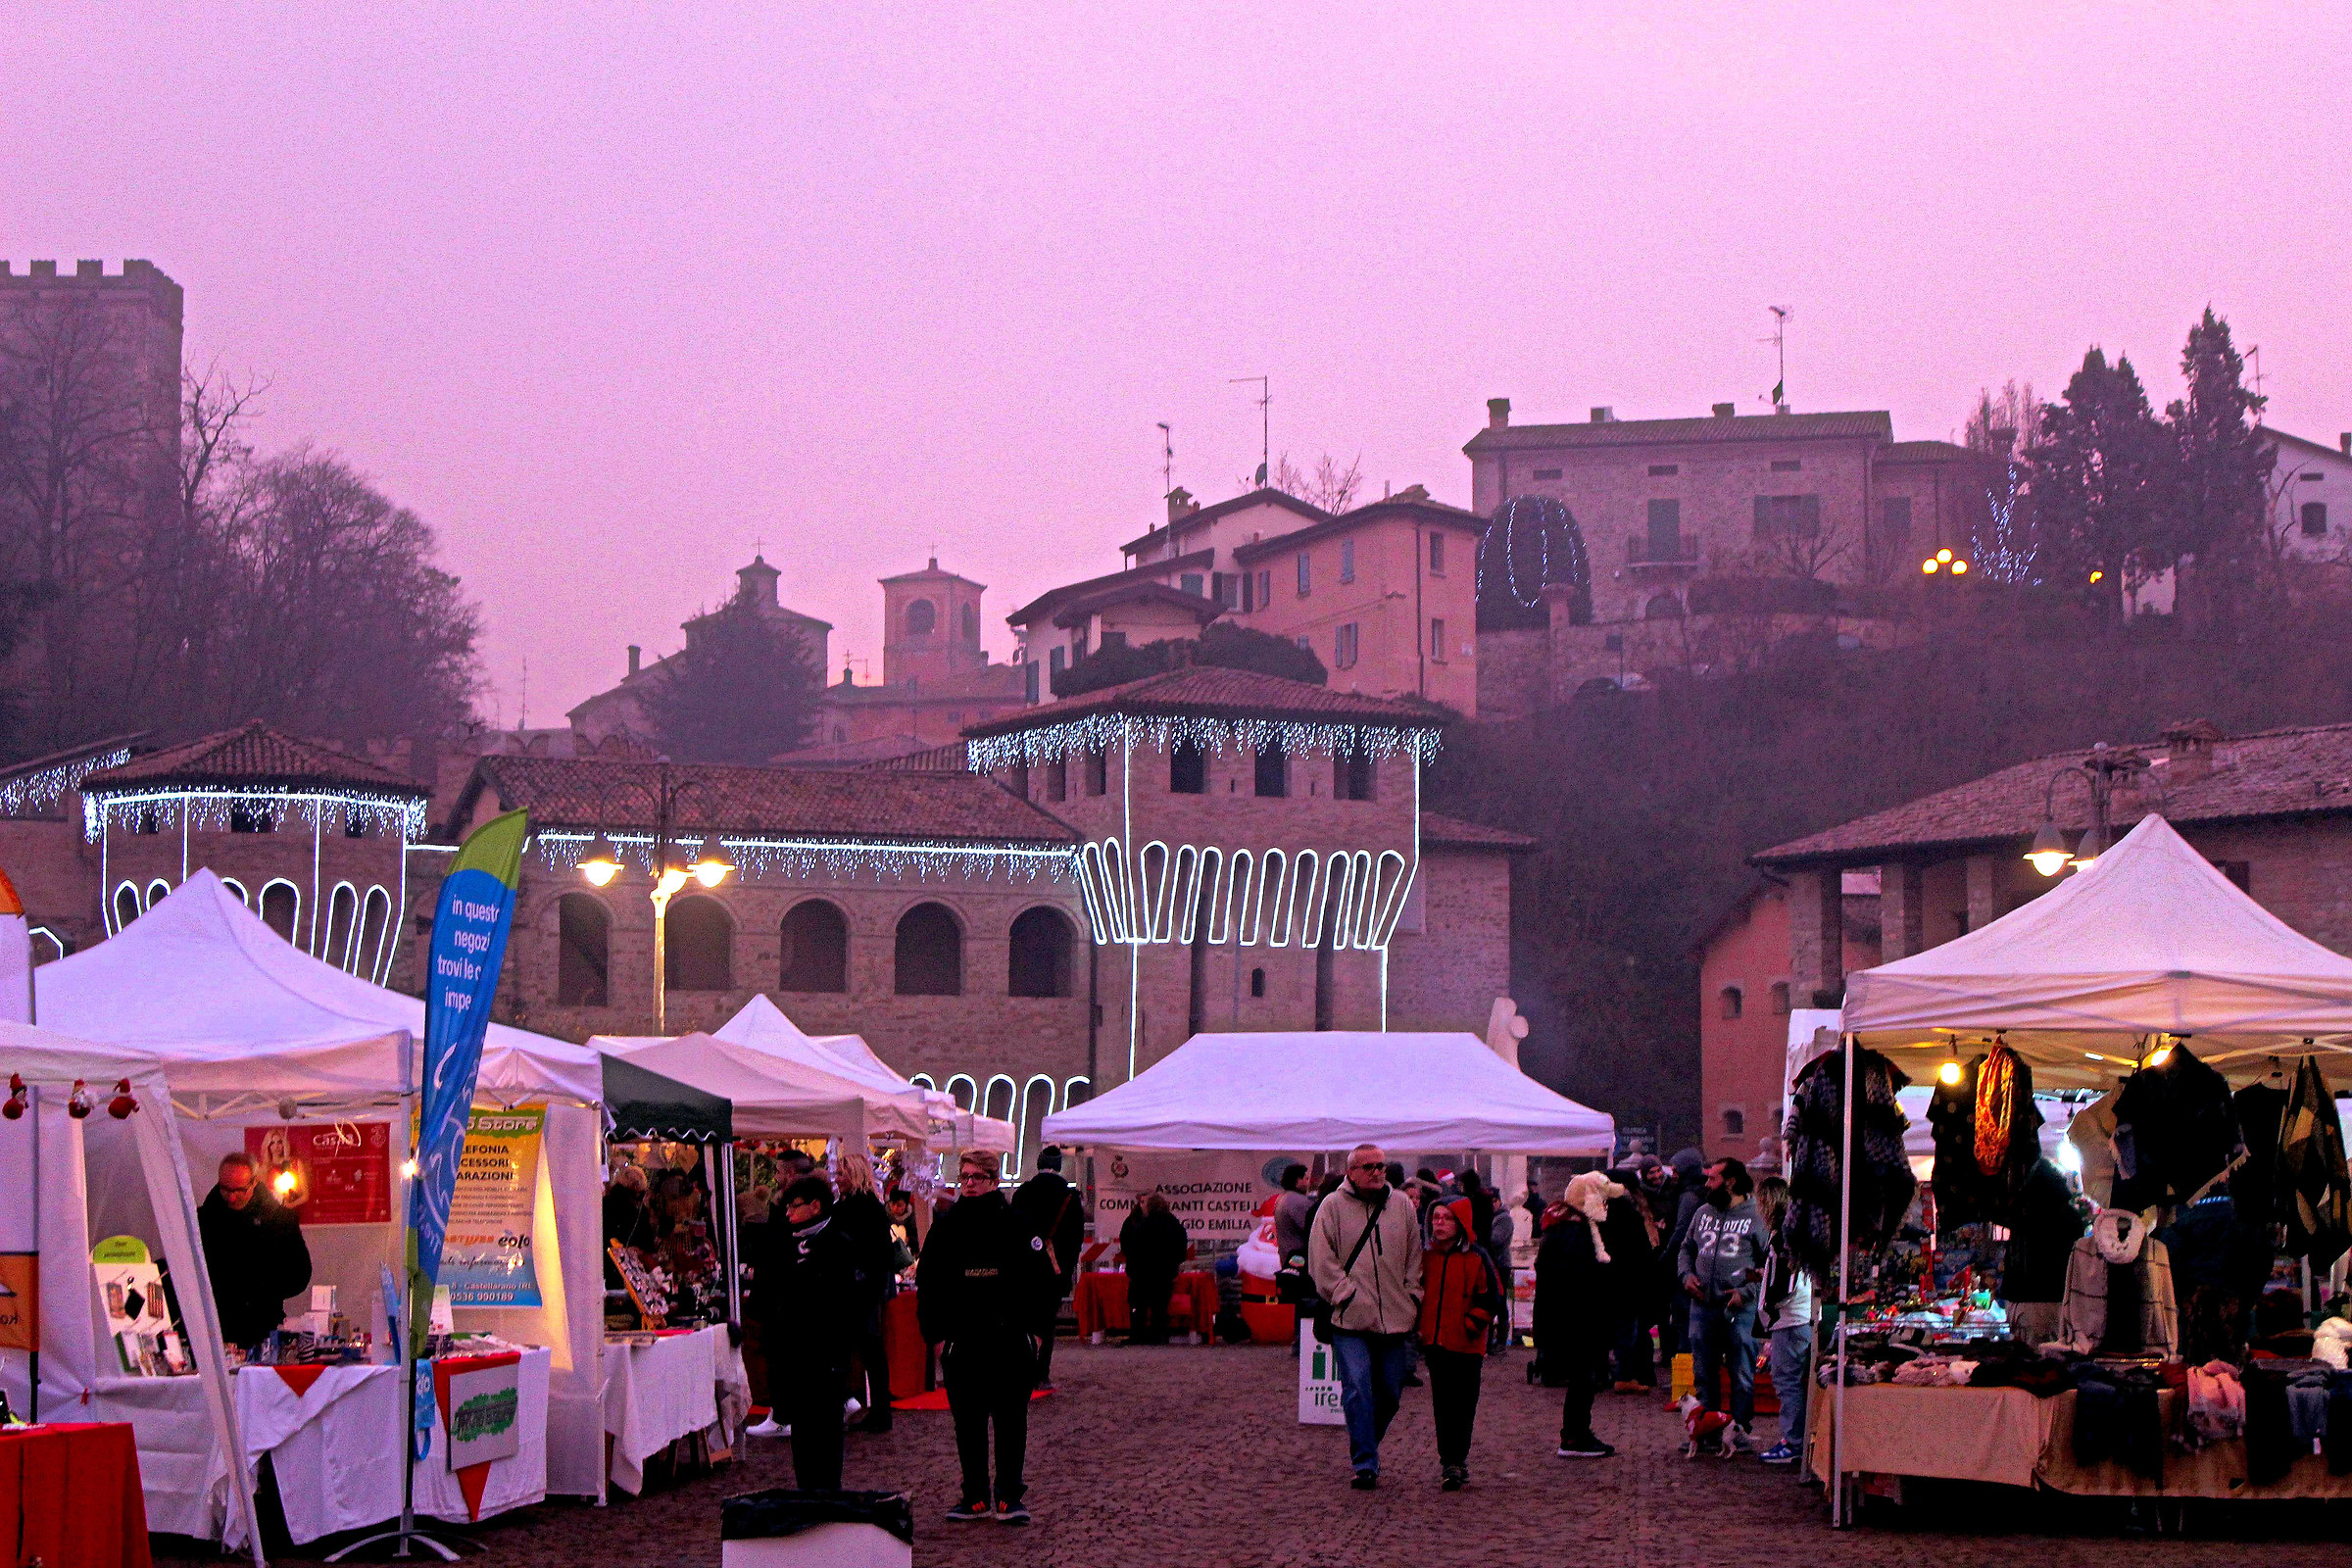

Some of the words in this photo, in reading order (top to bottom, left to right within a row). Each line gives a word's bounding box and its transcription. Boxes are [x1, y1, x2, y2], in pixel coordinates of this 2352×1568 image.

[452, 894, 463, 915] in
[454, 929, 491, 955] negozi
[437, 954, 464, 978] trovi
[464, 957, 473, 980] le
[460, 1158, 509, 1168] CESSORI
[456, 1171, 514, 1181] ARAZIONI
[1155, 1181, 1252, 1196] ASSOCIAZIONE
[1206, 1199, 1260, 1212] CASTELL
[1207, 1217, 1252, 1231] EMILIA
[1714, 1217, 1752, 1235] LOUIS
[1698, 1230, 1740, 1257] 23
